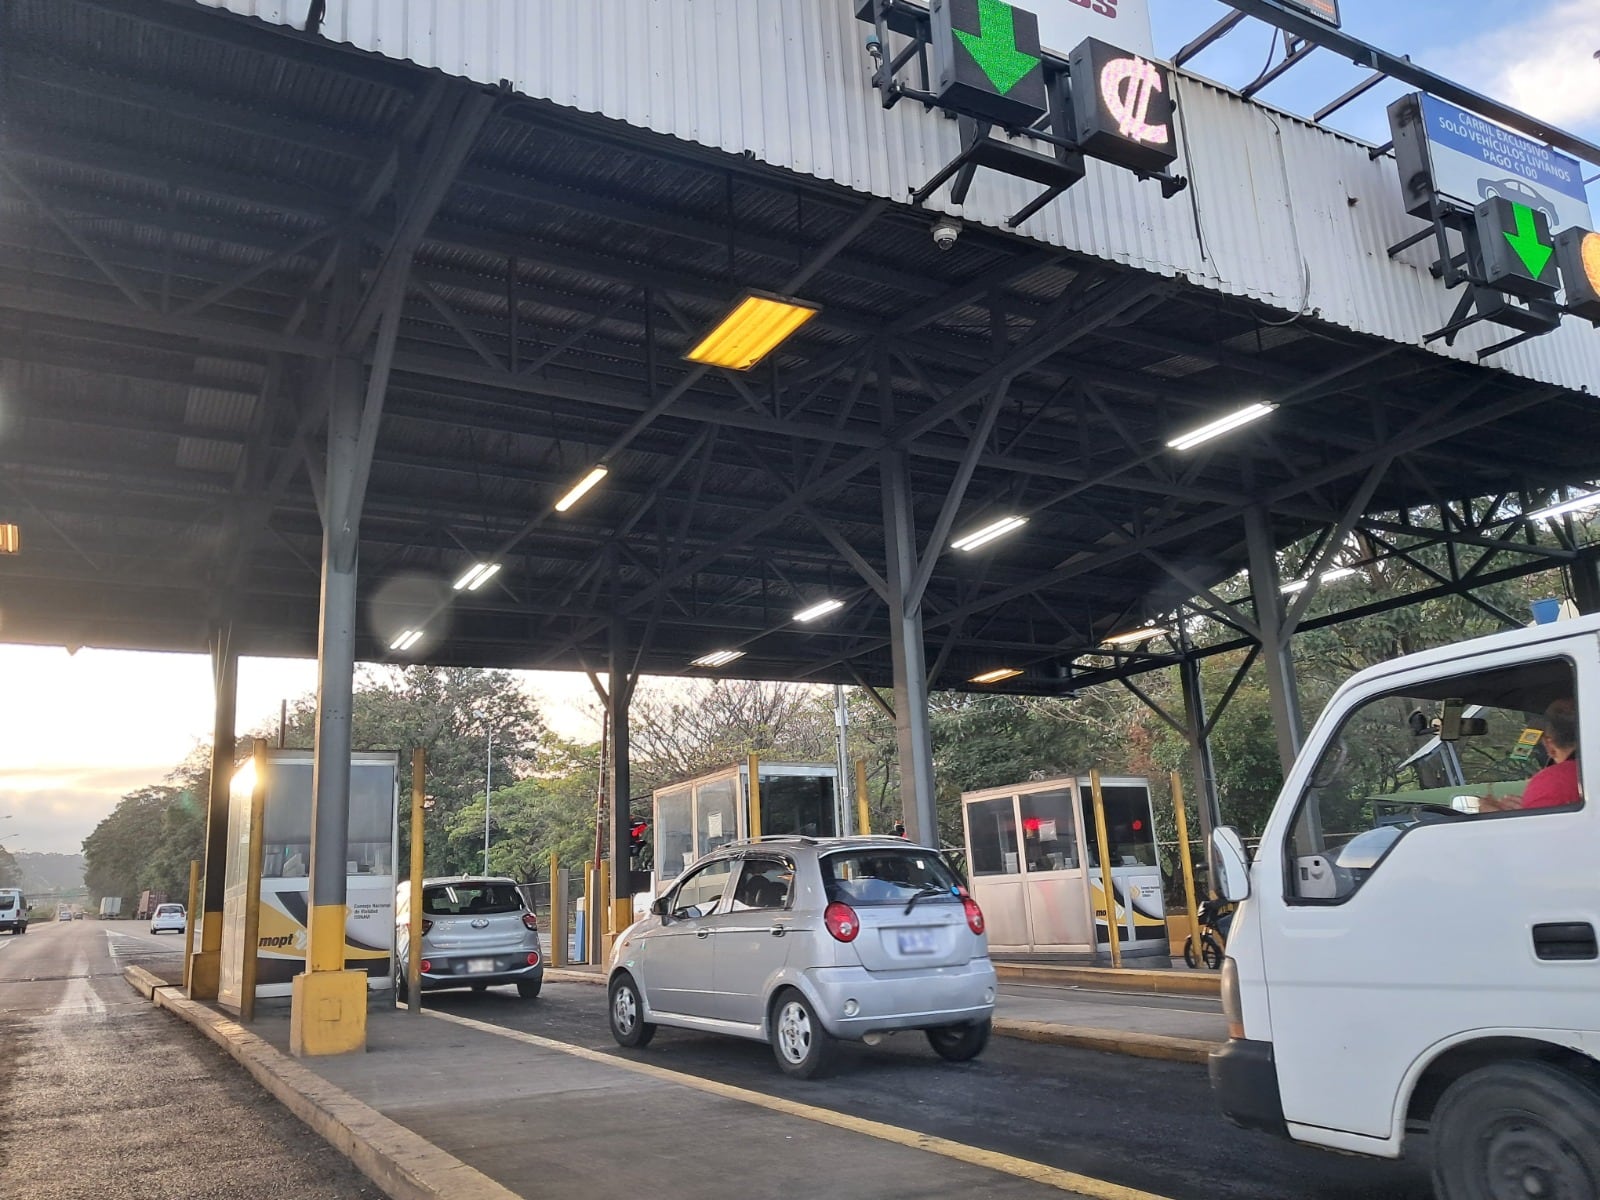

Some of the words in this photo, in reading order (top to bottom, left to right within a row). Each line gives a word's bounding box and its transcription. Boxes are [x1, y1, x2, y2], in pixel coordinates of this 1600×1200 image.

[1438, 117, 1468, 138] SOLO
[1469, 130, 1526, 162] VEHÍCULOS
[1527, 154, 1571, 182] LIVIANOS
[1458, 112, 1495, 137] CARRIL
[1496, 130, 1549, 160] EXCLUSIVO
[1483, 148, 1512, 169] PAGO
[259, 934, 293, 948] mopt
